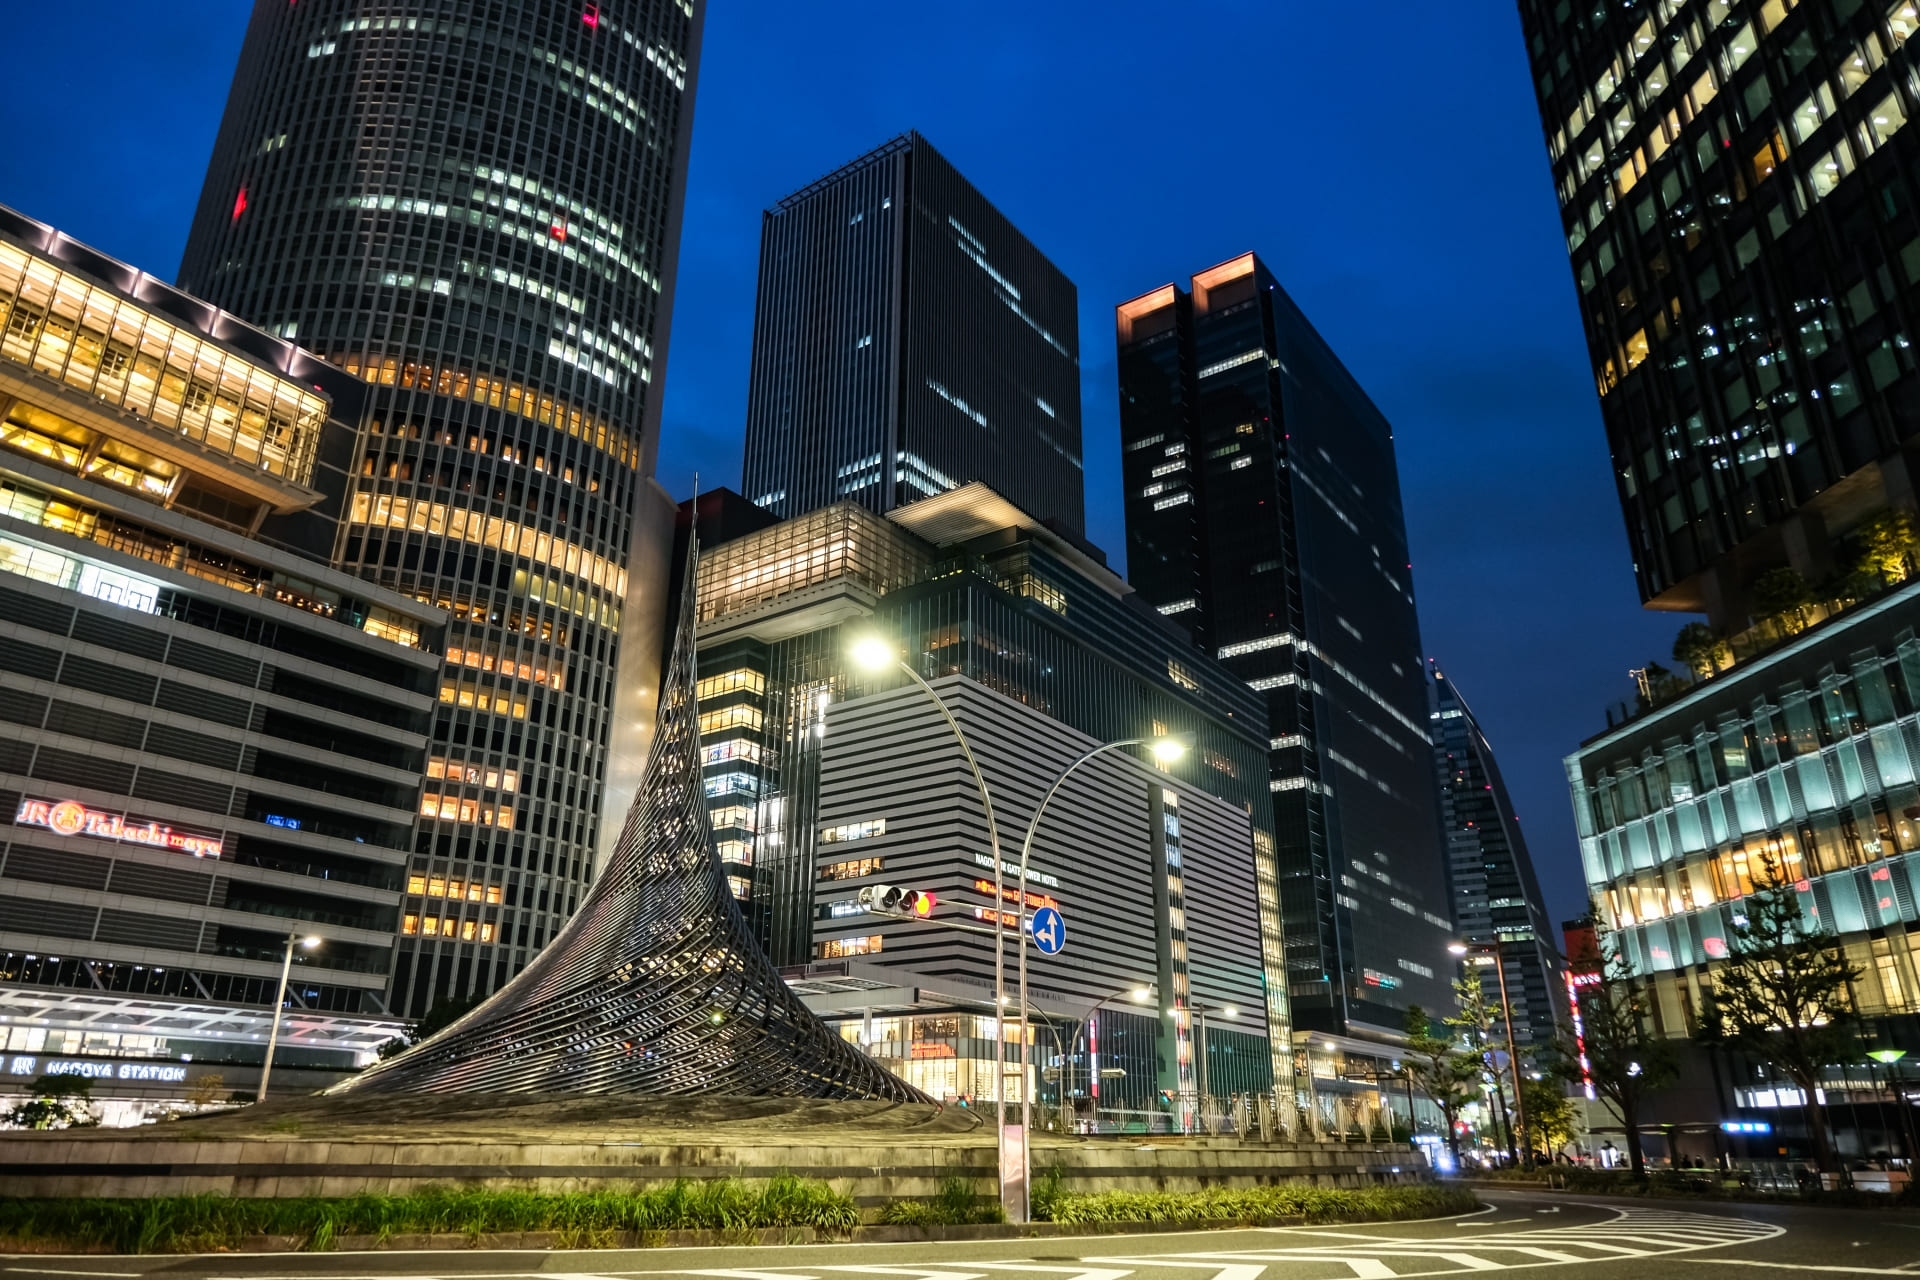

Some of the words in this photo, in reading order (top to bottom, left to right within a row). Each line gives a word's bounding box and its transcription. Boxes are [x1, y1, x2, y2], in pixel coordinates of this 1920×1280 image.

[17, 800, 50, 825] JR
[86, 811, 222, 857] Takashimaya
[975, 853, 997, 869] NAGOY
[1041, 873, 1058, 887] HOTEL
[47, 1061, 112, 1078] NAGOYA
[119, 1064, 187, 1082] STATION
